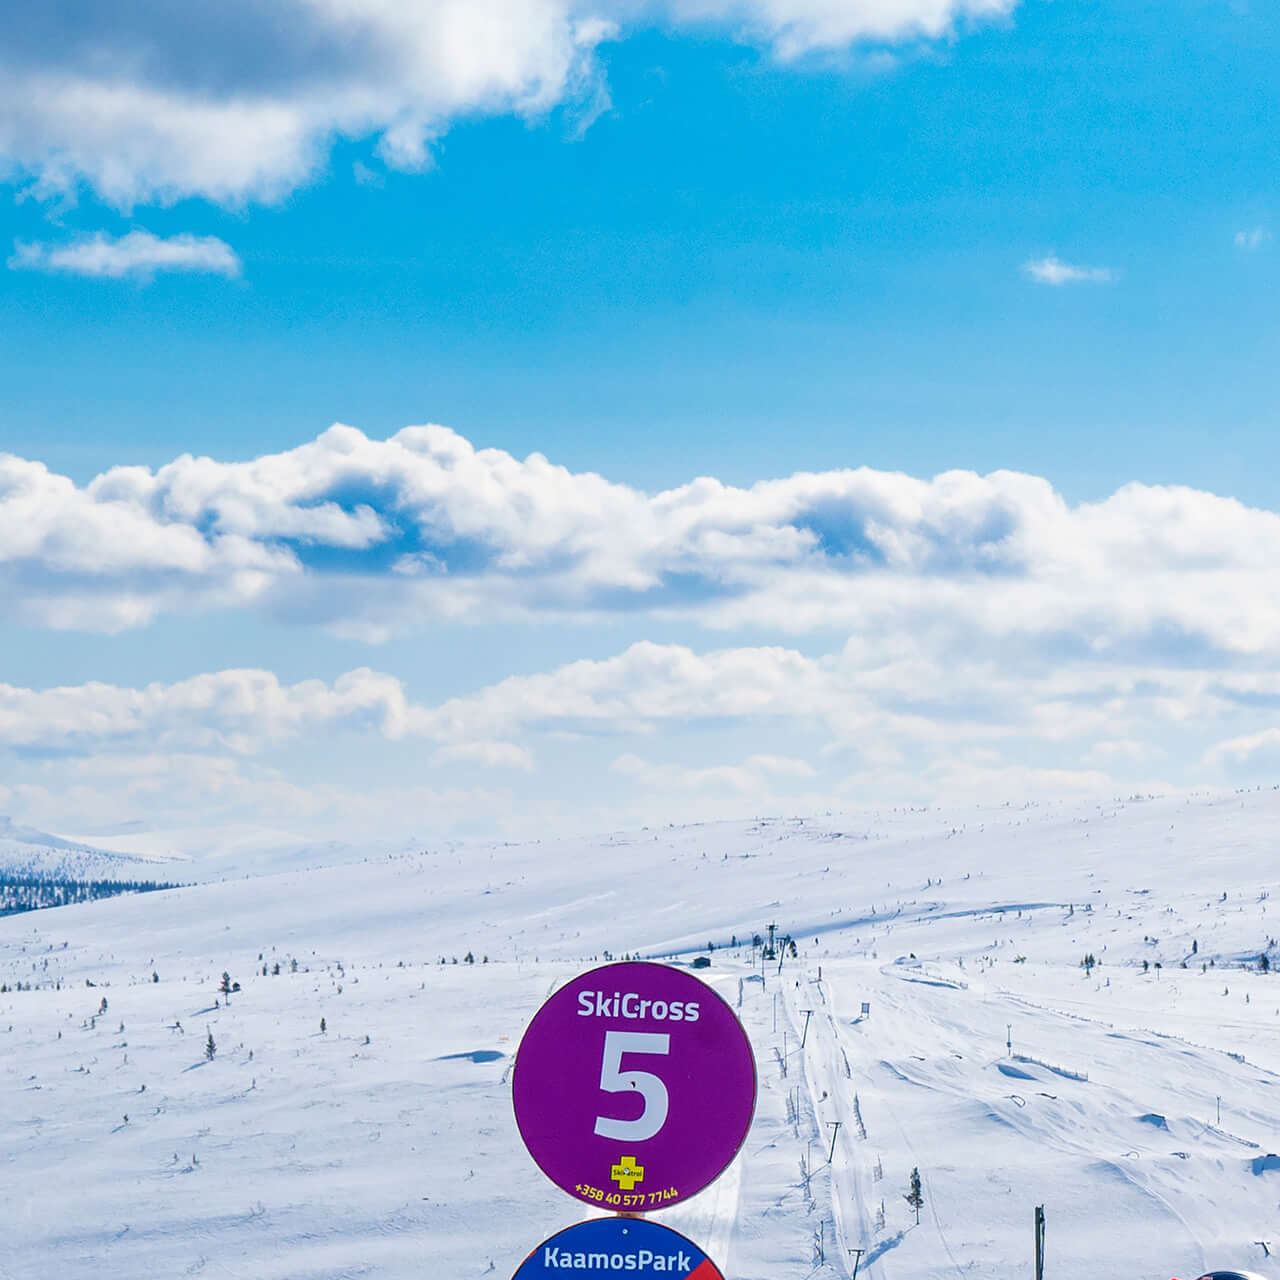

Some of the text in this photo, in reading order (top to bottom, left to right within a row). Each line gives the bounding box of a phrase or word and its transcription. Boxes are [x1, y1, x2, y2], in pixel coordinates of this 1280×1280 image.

[577, 991, 700, 1022] SkiCross
[594, 1030, 670, 1142] 5
[575, 1183, 679, 1206] +358 40 577 7744
[544, 1247, 691, 1272] KaamosPark
